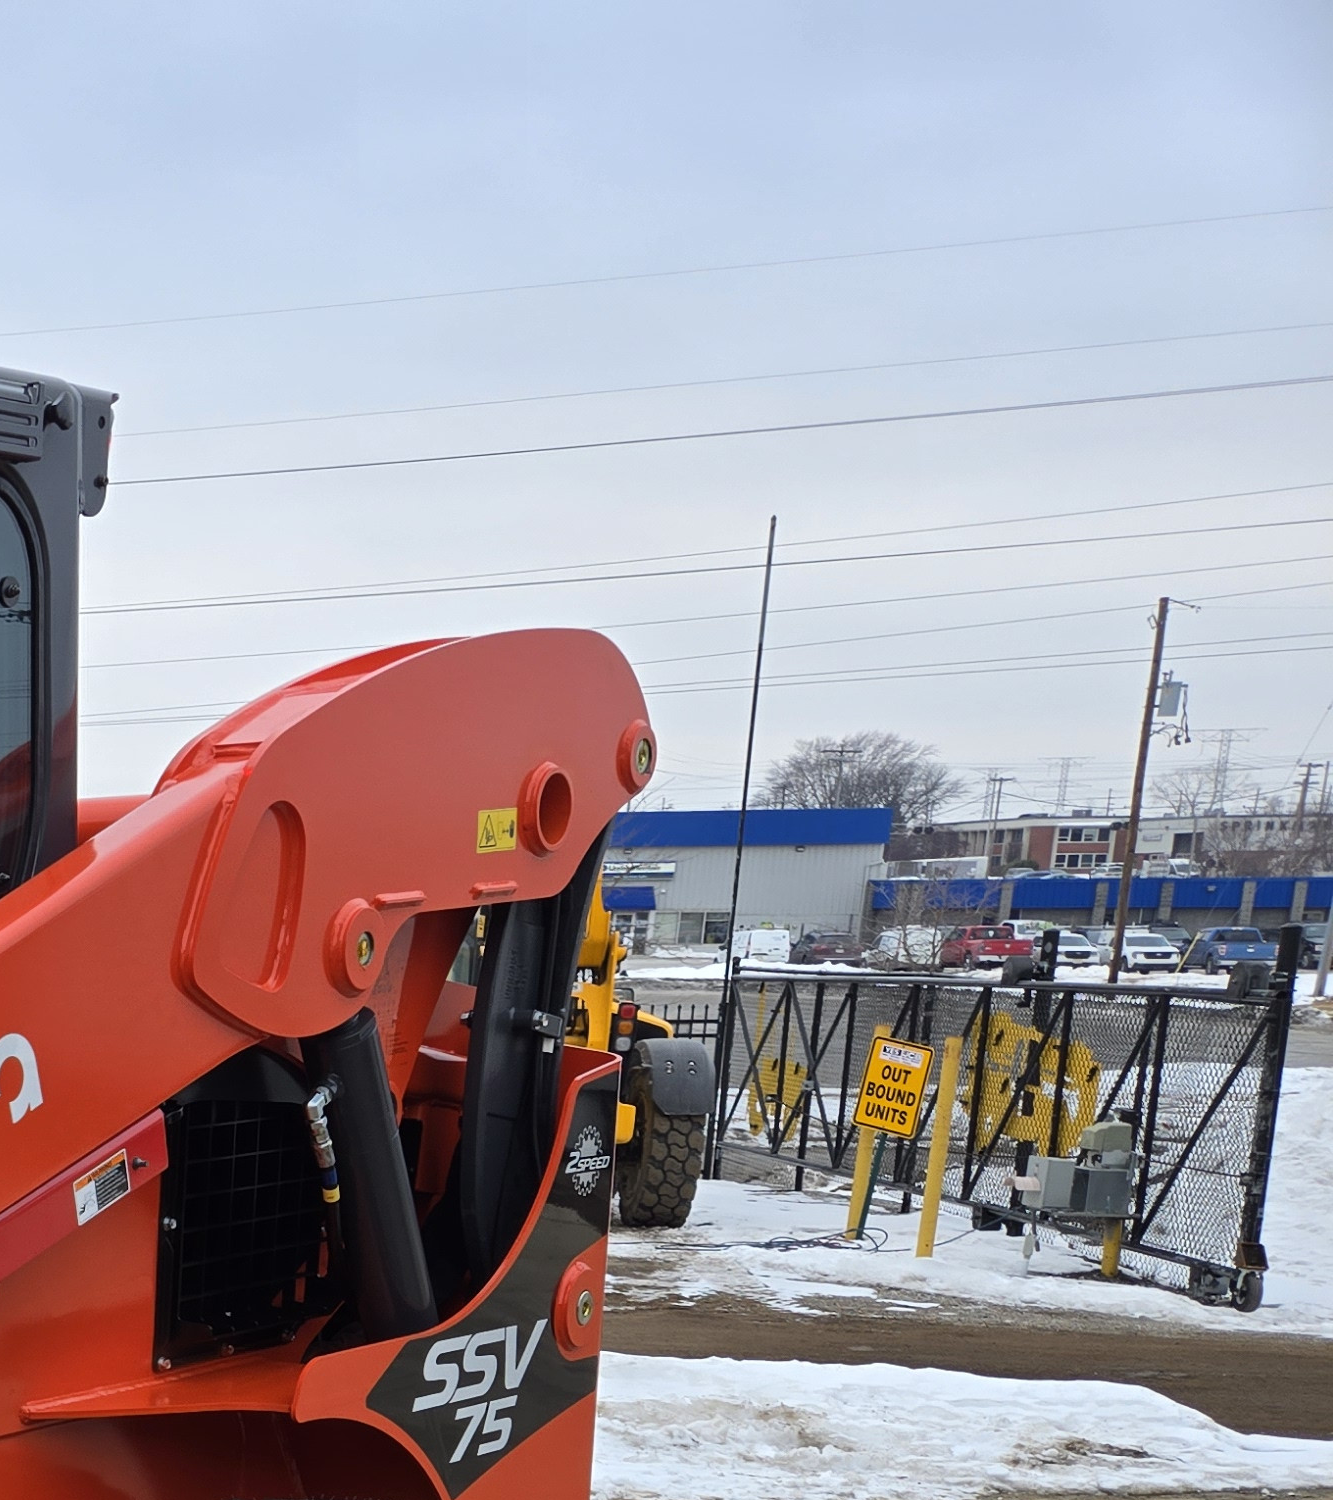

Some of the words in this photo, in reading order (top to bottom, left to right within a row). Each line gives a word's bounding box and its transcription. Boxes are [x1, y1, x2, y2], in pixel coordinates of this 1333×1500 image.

[881, 1064, 912, 1085] OUT
[865, 1081, 917, 1107] BOUND
[864, 1101, 908, 1126] UNITS
[412, 1318, 549, 1413] SSV
[449, 1394, 518, 1464] 75
